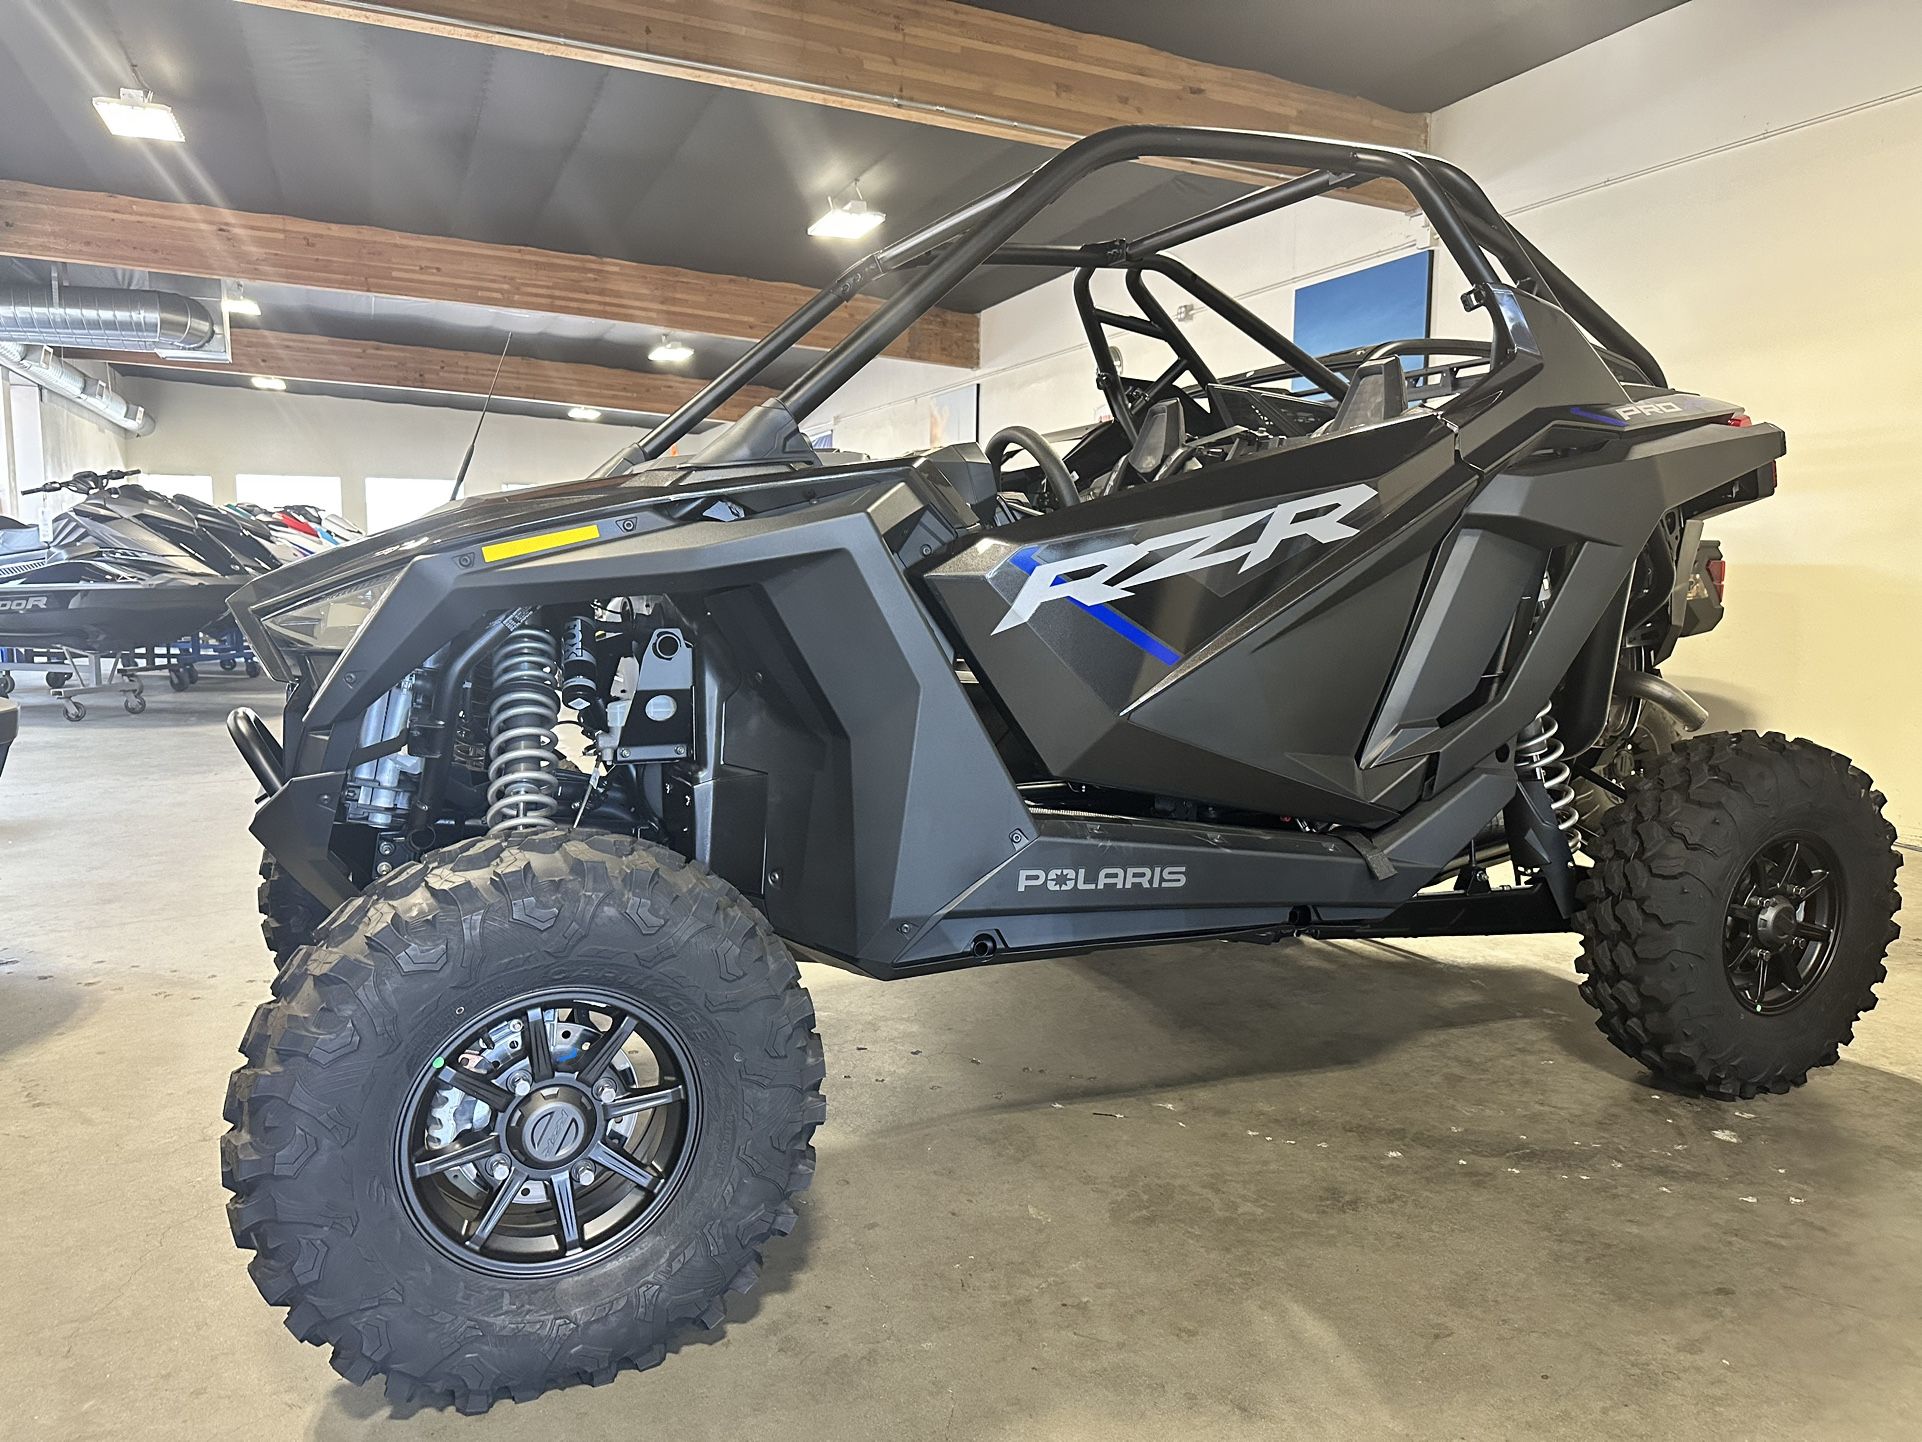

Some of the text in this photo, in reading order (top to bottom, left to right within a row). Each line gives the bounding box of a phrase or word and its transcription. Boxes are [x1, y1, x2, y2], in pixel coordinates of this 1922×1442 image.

[1615, 402, 1683, 421] PRO
[990, 483, 1379, 636] RZR
[1017, 866, 1187, 892] POLARIS
